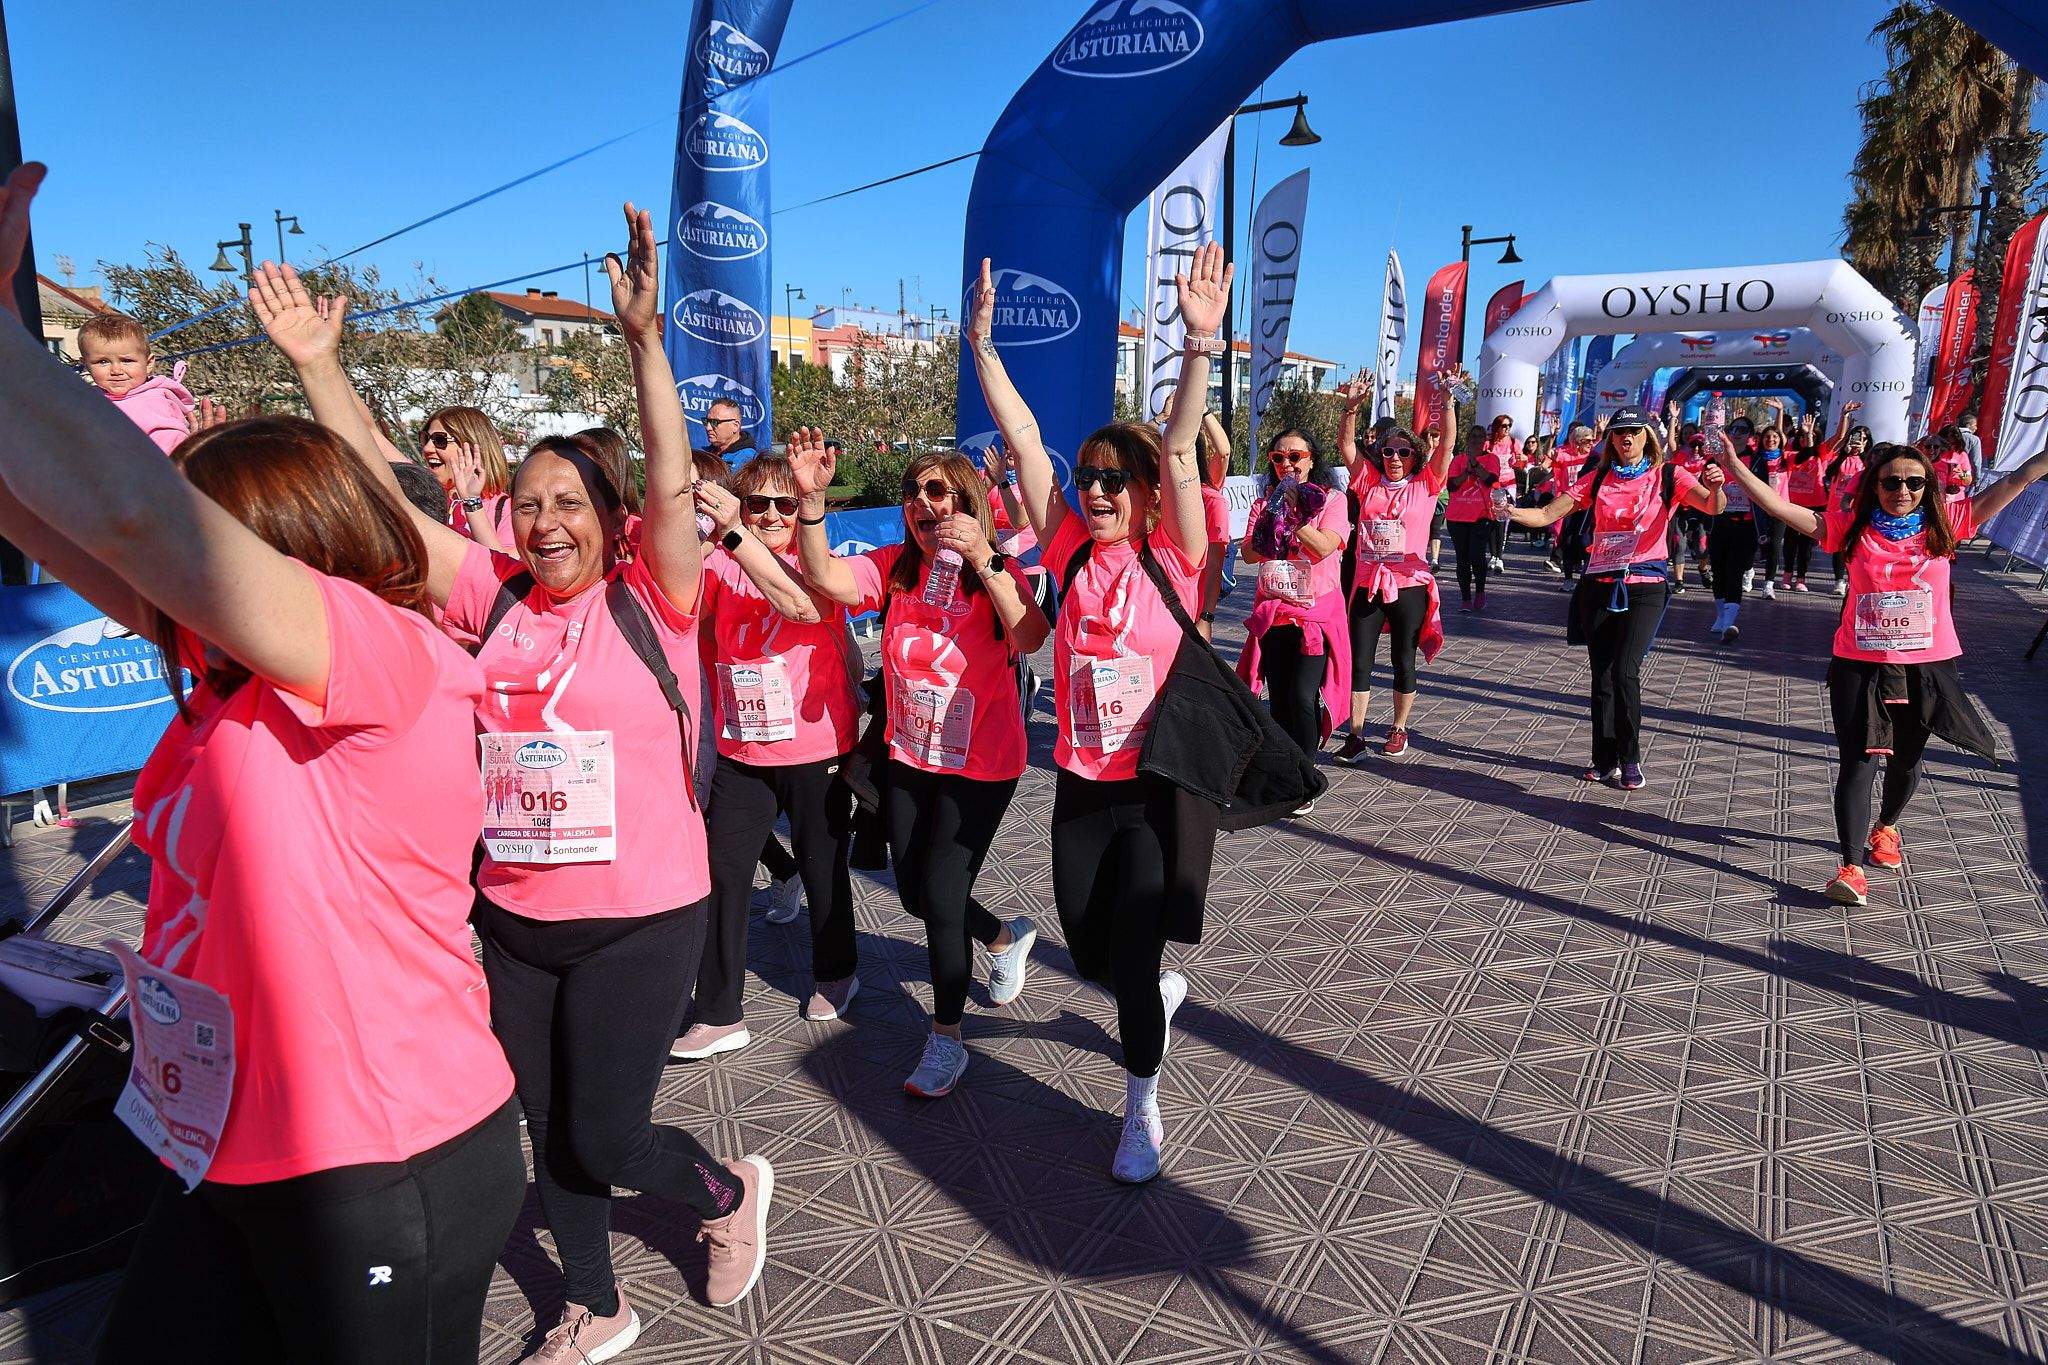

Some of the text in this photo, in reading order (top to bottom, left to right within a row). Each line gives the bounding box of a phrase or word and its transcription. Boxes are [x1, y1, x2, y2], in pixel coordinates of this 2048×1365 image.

[1083, 17, 1185, 37] CENTRAL LECHERA
[1059, 30, 1190, 65] ASTURIANA
[682, 219, 759, 250] ASTURIANA
[1601, 279, 1775, 319] OYSHO
[681, 304, 757, 336] ASTURIANA
[1826, 310, 1884, 324] OYSHO
[1432, 286, 1454, 368] Santander
[1505, 325, 1553, 337] OYSHO
[1707, 372, 1786, 383] VOLVO
[1481, 387, 1524, 399] OYSHO
[1851, 381, 1906, 393] OYSHO
[1277, 581, 1298, 590] 016
[1881, 617, 1910, 628] 016
[58, 648, 128, 665] CENTRAL
[737, 699, 766, 711] 016
[1098, 700, 1124, 717] 16
[914, 716, 943, 735] 016
[518, 750, 563, 764] ASTURIANA
[520, 791, 568, 812] 016
[531, 817, 551, 827] 1048
[496, 843, 533, 855] OYSHO
[553, 845, 598, 855] Santander
